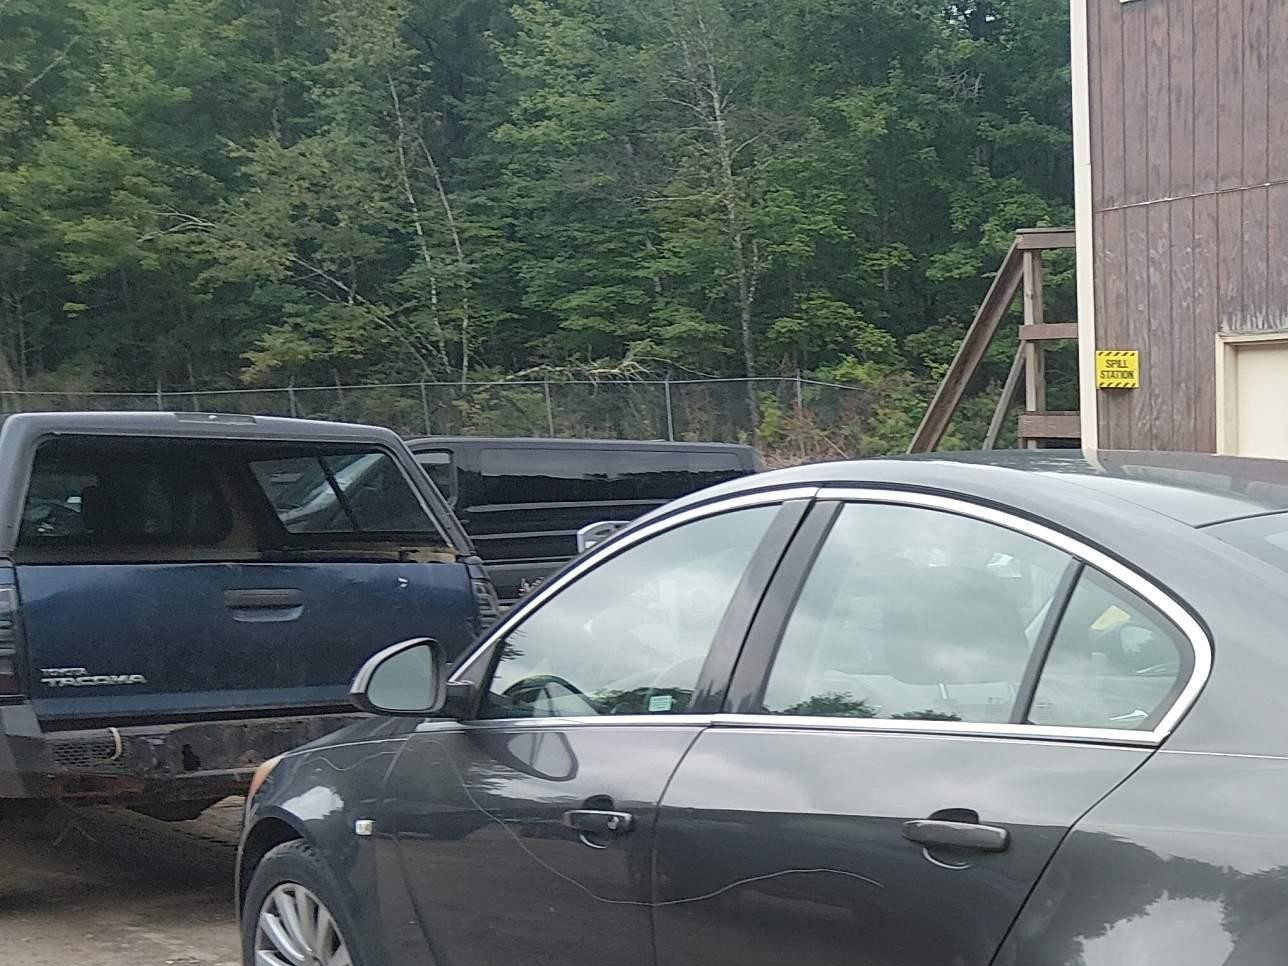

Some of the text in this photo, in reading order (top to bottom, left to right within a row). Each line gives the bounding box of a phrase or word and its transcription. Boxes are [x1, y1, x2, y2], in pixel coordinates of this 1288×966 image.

[1105, 359, 1129, 369] SPILL
[1100, 370, 1135, 379] STATION
[41, 674, 147, 688] TACOMA
